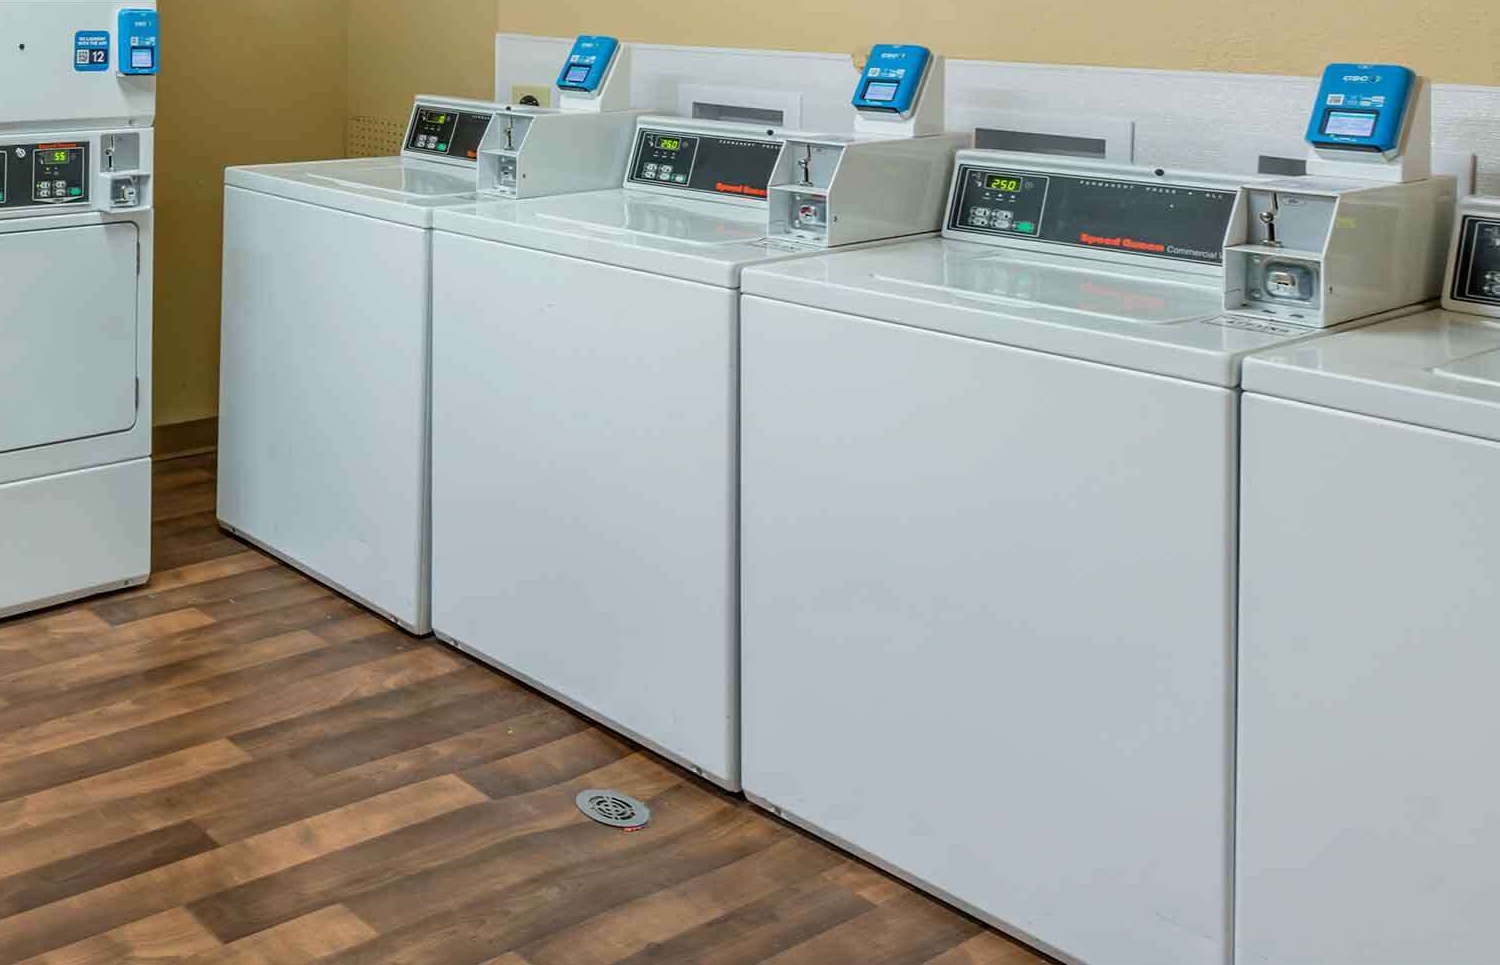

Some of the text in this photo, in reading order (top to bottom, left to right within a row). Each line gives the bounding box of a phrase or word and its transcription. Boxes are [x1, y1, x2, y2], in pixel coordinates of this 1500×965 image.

[92, 51, 105, 63] 12
[991, 179, 1017, 190] 250
[1166, 245, 1219, 259] Commercial
